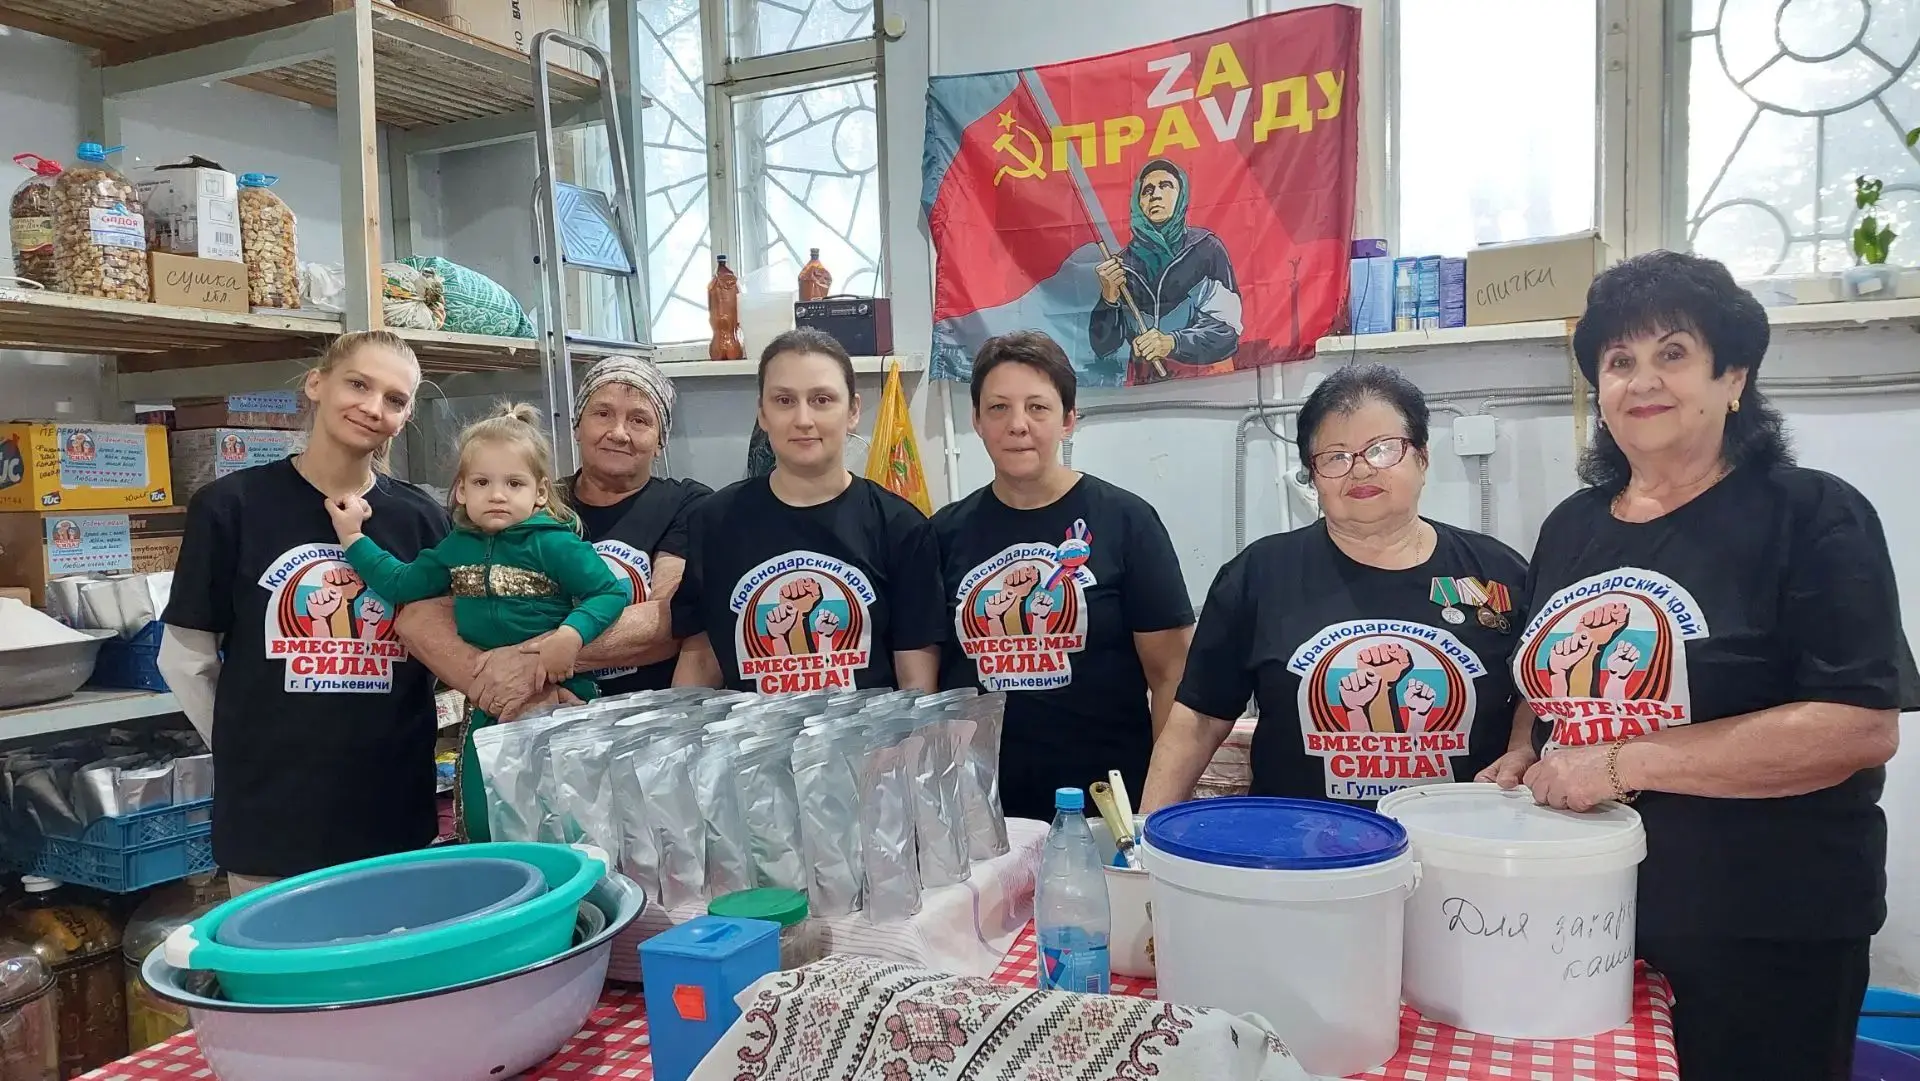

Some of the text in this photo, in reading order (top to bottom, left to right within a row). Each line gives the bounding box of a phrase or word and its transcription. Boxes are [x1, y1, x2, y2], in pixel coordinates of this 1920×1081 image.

[1050, 70, 1345, 171] ПРАVДУ
[0, 452, 21, 483] UC
[43, 495, 59, 505] TUC
[151, 491, 165, 501] TUC
[265, 549, 345, 587] Краснодар
[732, 557, 874, 610] Краснодарский край
[1524, 576, 1703, 639] Краснодарский край
[271, 640, 405, 658] ВМЕСТЕ МЫ
[963, 635, 1083, 654] ВМЕСТЕ МЫ
[1293, 623, 1482, 675] Краснодарский край
[291, 655, 388, 676] СИЛА!
[742, 651, 867, 674] ВМЕСТЕ МЫ
[979, 650, 1066, 675] СИЛА!
[290, 677, 390, 692] г. Гулькевичи
[760, 668, 850, 695] СИЛА!
[990, 674, 1069, 690] Гулькевичи
[1623, 702, 1685, 720] МЫ
[1306, 732, 1465, 753] ВМЕСТЕ МЫ
[1330, 753, 1448, 779] СИЛА!
[1331, 781, 1413, 800] г. Гульк
[1442, 897, 1529, 943] Для
